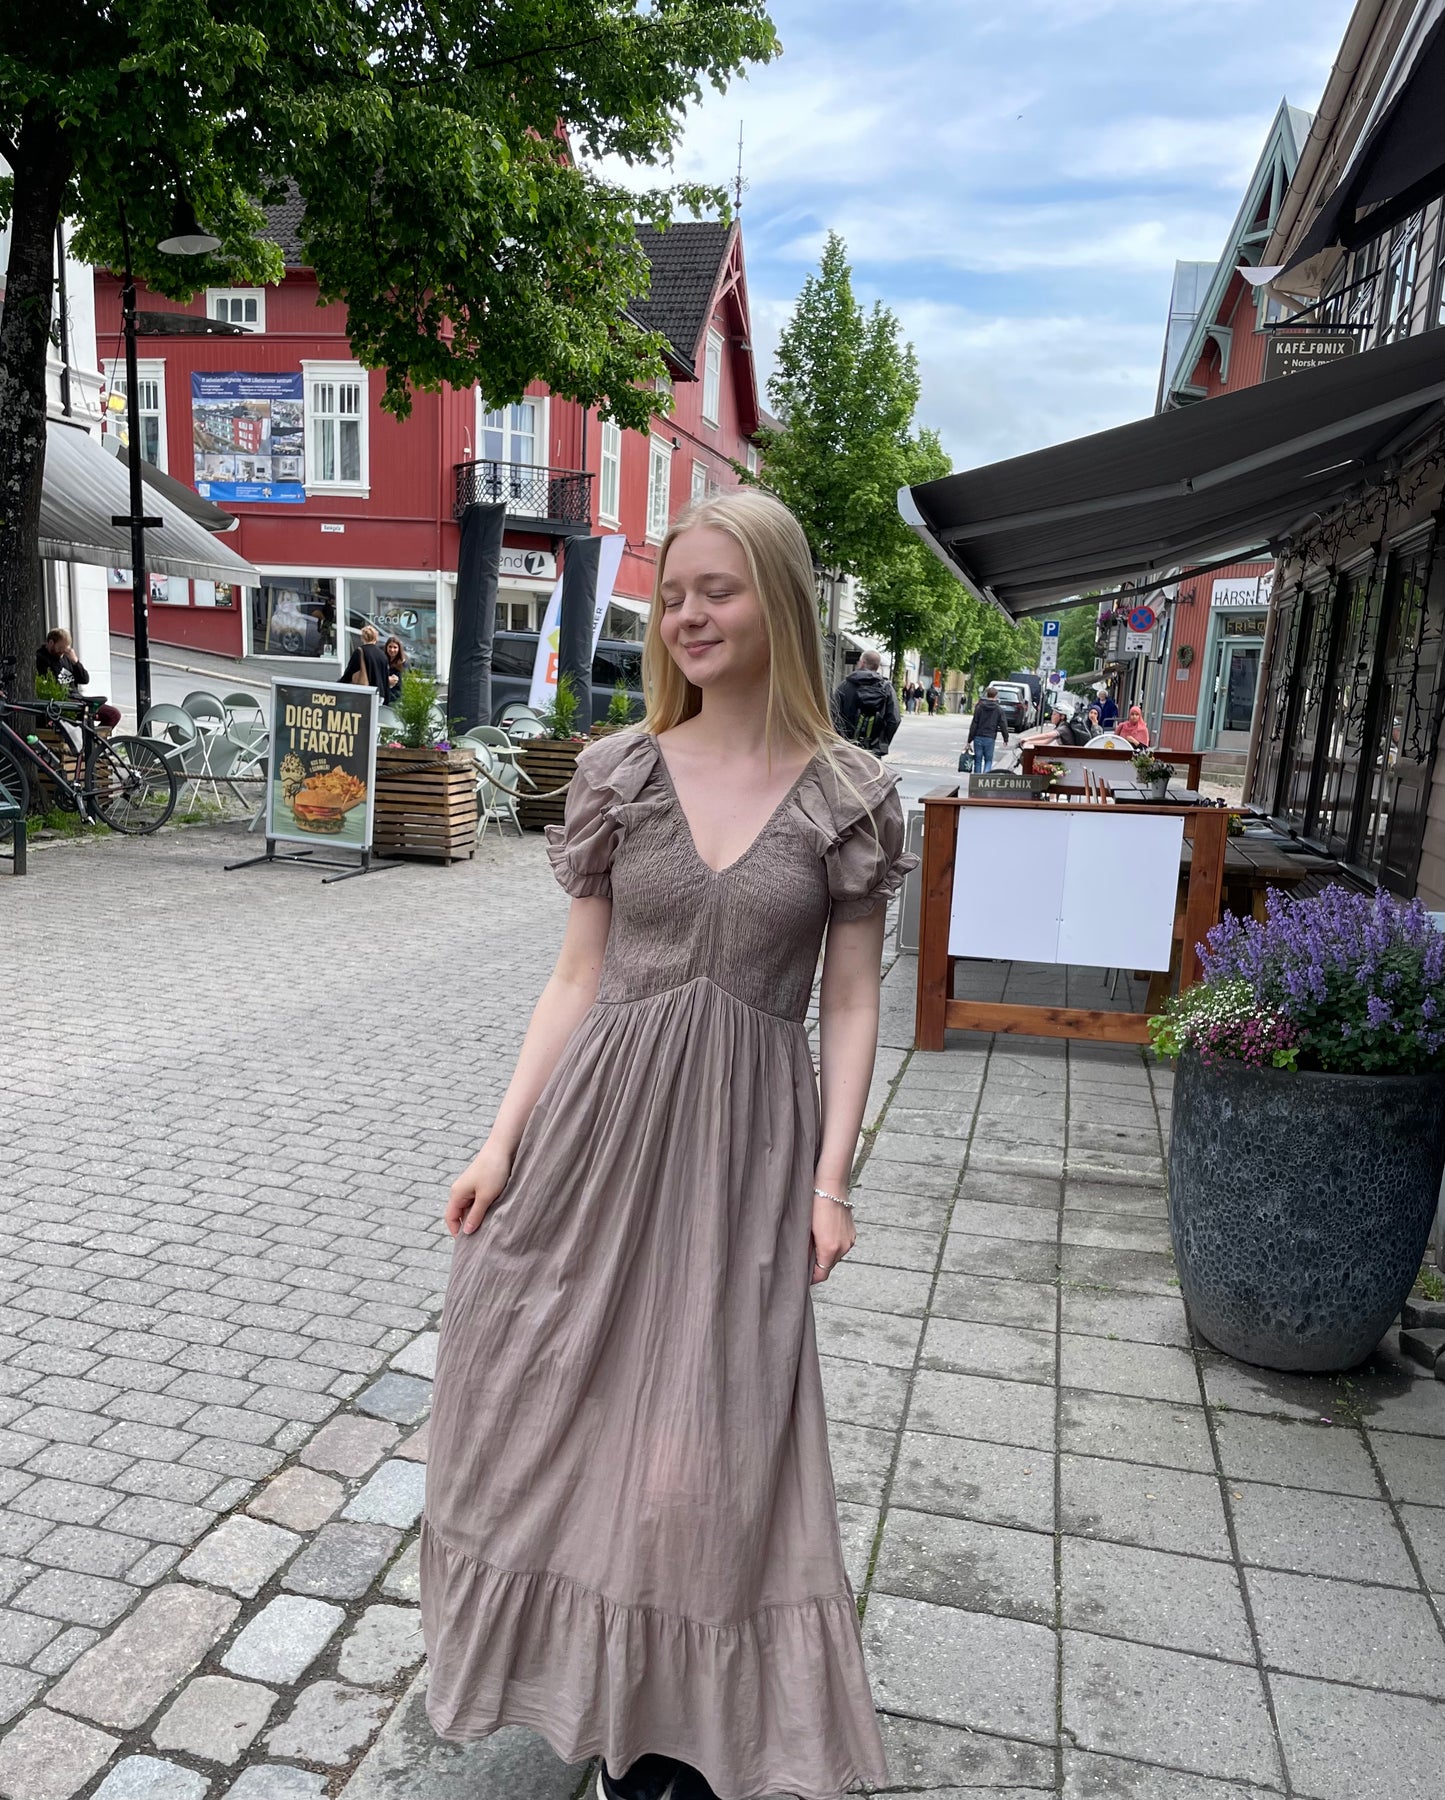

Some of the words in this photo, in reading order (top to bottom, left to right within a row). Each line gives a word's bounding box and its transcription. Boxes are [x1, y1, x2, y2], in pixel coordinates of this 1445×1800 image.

[1276, 341, 1306, 354] KAFÉ
[1310, 343, 1345, 354] FØNIX
[1292, 359, 1316, 367] Norsk
[1046, 622, 1056, 635] P
[1227, 619, 1266, 632] FRISØ
[285, 704, 323, 730] DIGG
[327, 709, 362, 735] MAT
[290, 728, 296, 749] I
[300, 729, 354, 757] FARTA!
[978, 778, 1001, 788] KAFÉ
[1004, 780, 1032, 789] FØNIX
